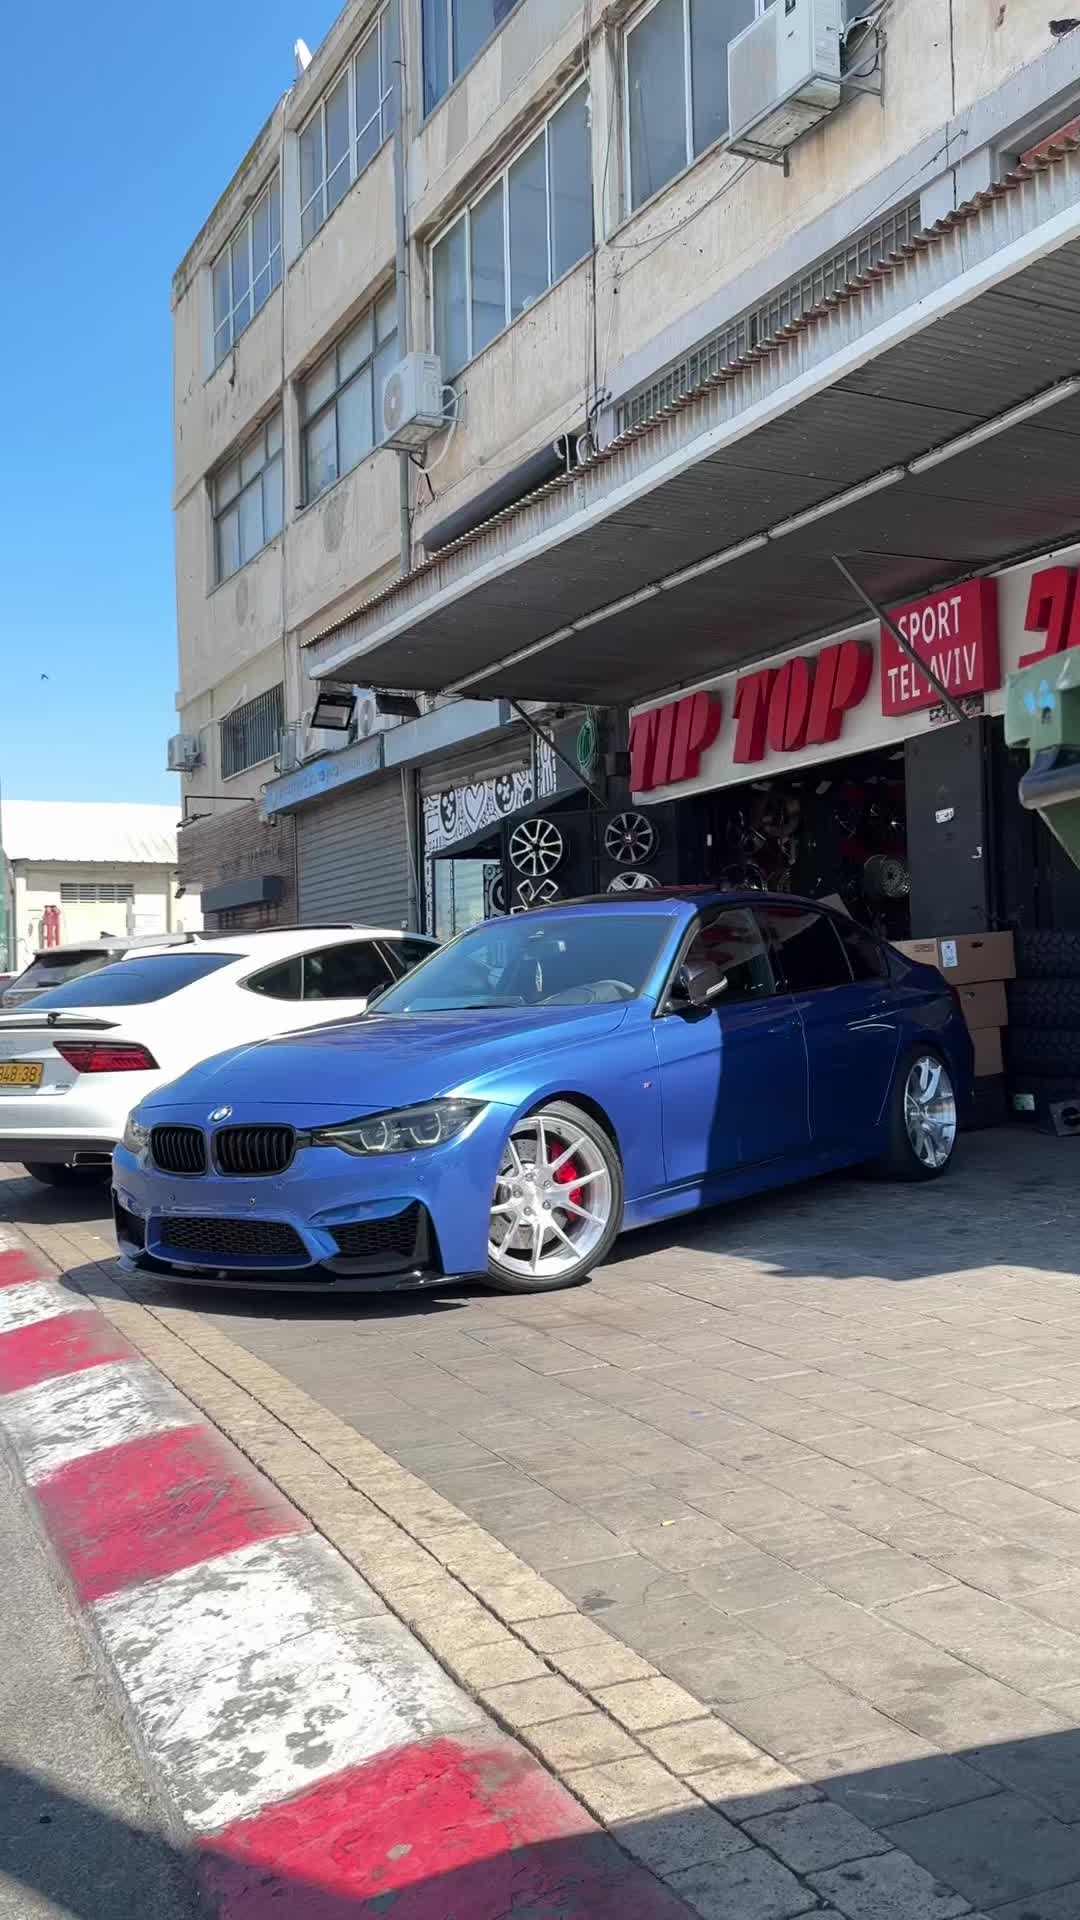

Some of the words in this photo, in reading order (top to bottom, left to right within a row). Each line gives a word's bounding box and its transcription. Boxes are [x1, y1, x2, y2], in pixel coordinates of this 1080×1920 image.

[898, 596, 961, 652] SPORT
[733, 640, 874, 764] TOP
[888, 663, 920, 703] TEL
[928, 642, 976, 693] AVIV
